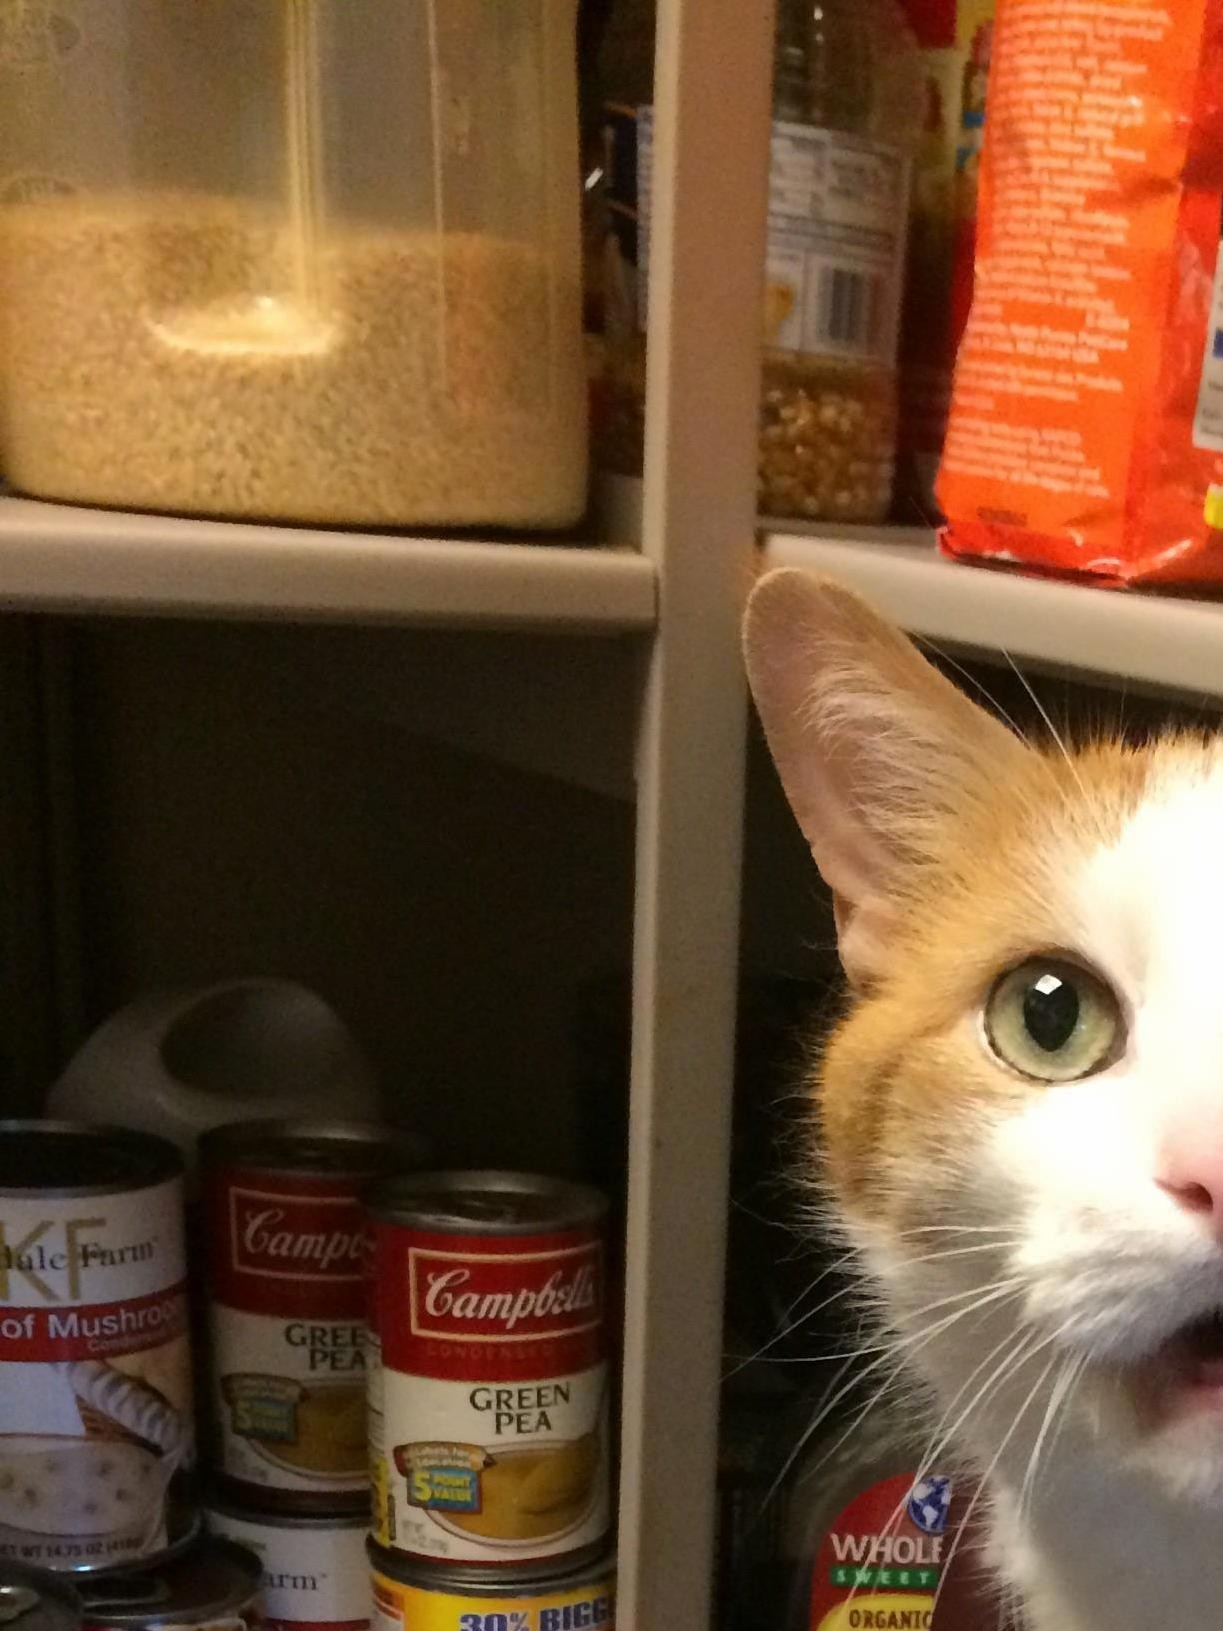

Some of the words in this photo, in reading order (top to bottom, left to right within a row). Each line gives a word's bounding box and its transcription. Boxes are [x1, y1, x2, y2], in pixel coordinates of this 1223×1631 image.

[1, 1313, 36, 1340] of
[48, 1299, 182, 1340] Mushroo
[284, 1322, 369, 1348] GREE
[308, 1350, 368, 1371] PEA
[469, 1381, 571, 1413] GREEN
[494, 1410, 552, 1436] PEA
[414, 1471, 432, 1502] 5
[836, 1568, 930, 1586] SWEET
[848, 1608, 932, 1630] ORGANIC
